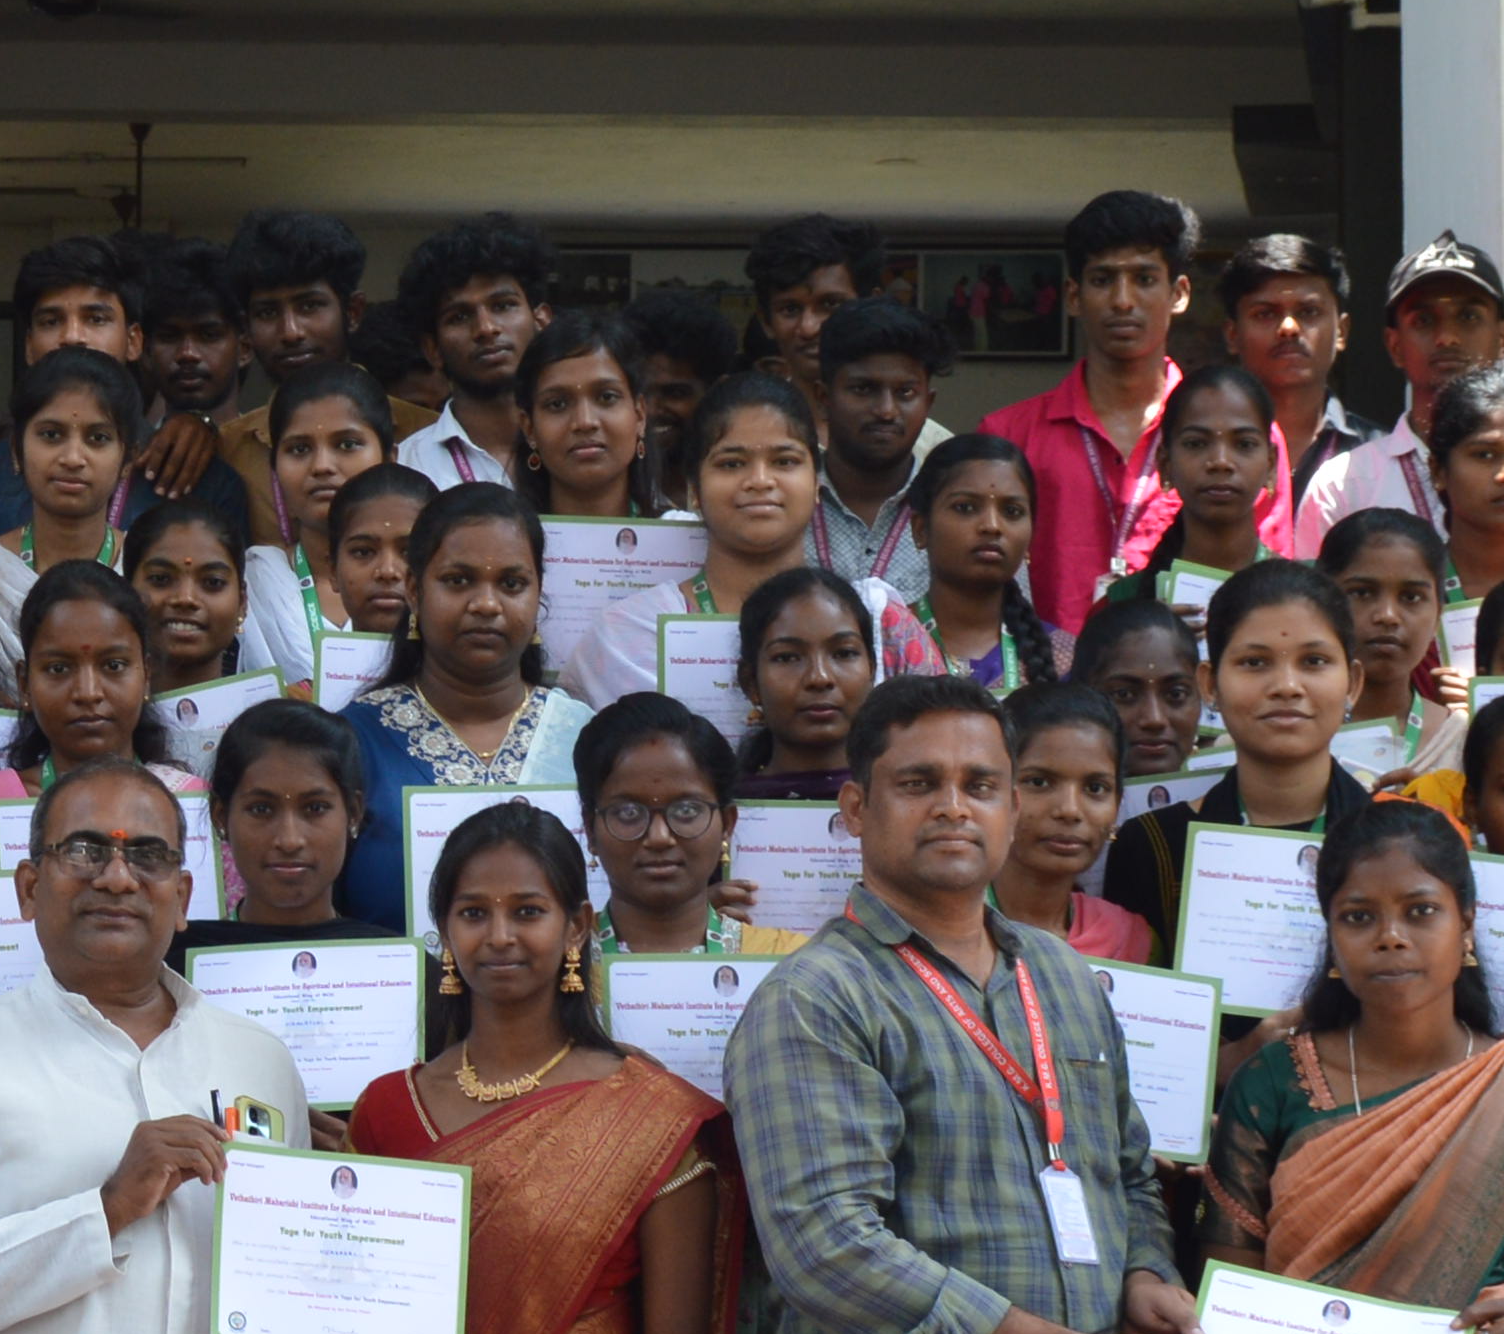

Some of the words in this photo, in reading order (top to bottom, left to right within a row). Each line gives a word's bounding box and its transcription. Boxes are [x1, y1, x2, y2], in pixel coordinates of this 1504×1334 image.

[930, 977, 947, 996] AND
[945, 995, 967, 1018] ARTS
[963, 1015, 975, 1030] OF
[974, 1027, 1007, 1066] COLLEGE
[1033, 1021, 1047, 1060] COLLEGE
[280, 1227, 299, 1239] Yoga
[303, 1229, 315, 1238] for
[320, 1231, 342, 1240] Youth
[347, 1233, 404, 1245] Empowerment
